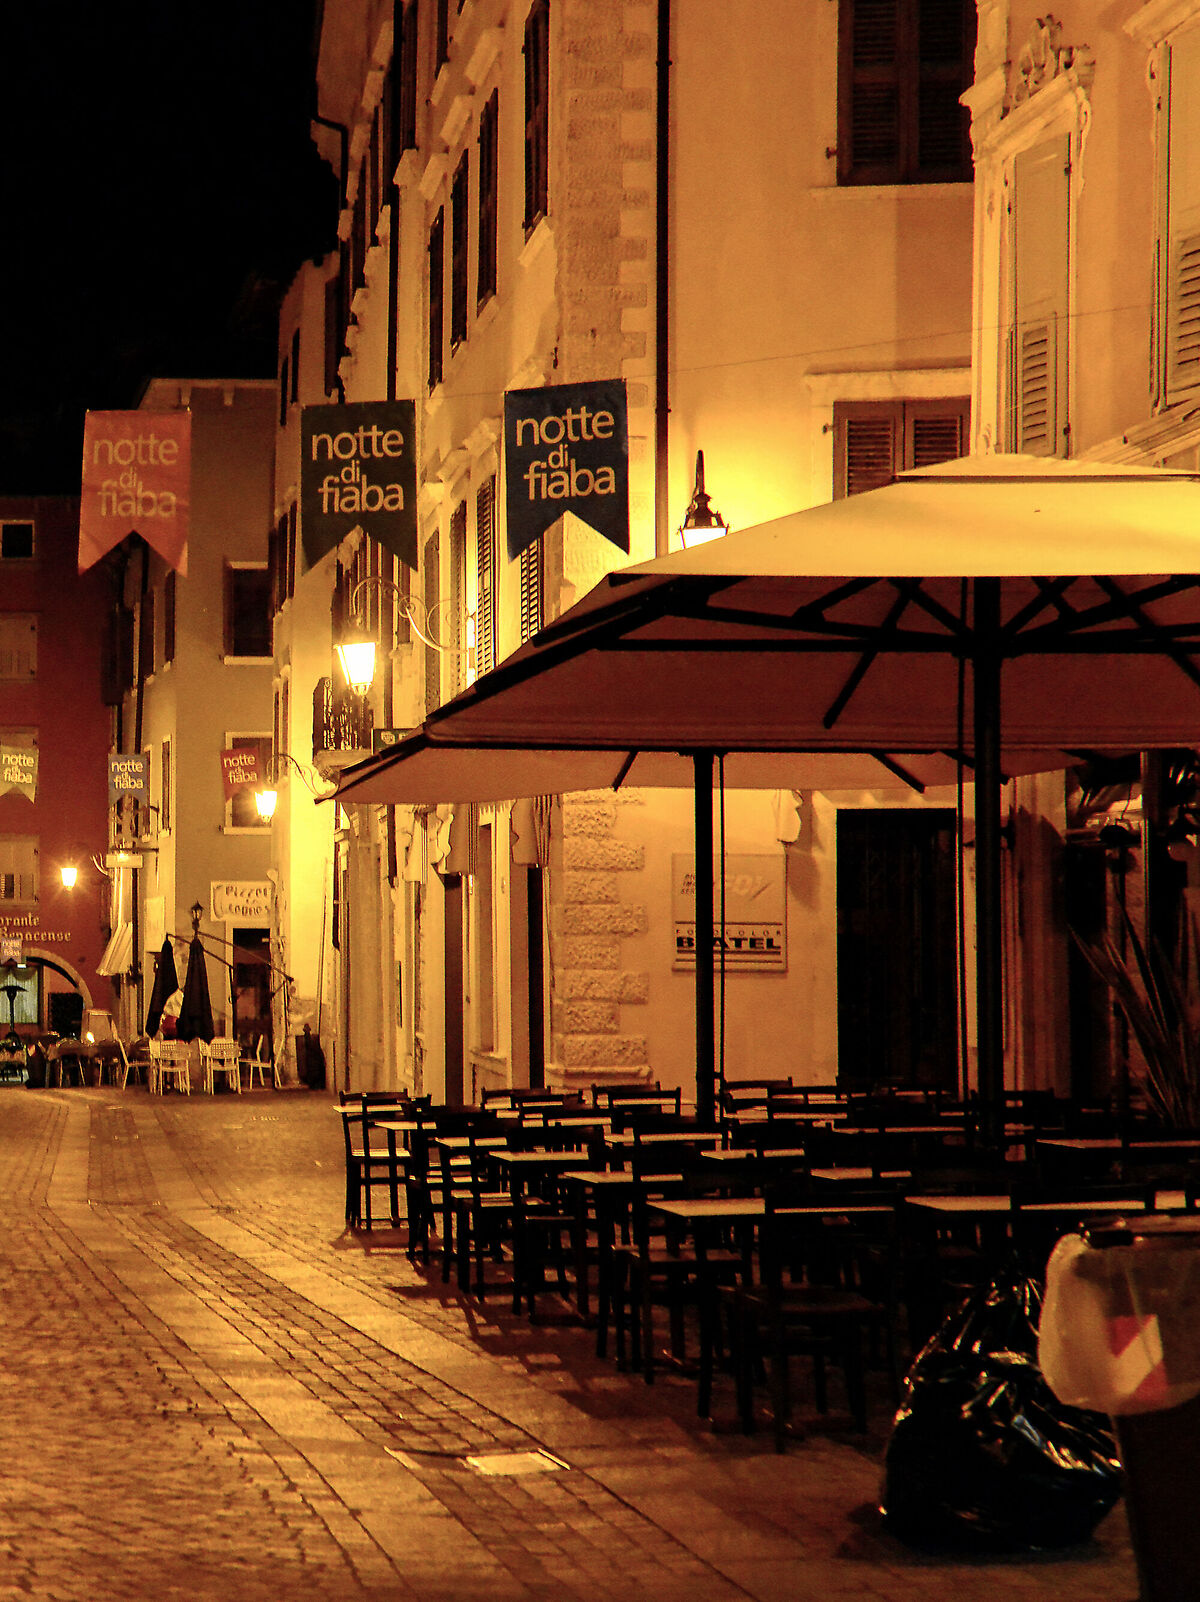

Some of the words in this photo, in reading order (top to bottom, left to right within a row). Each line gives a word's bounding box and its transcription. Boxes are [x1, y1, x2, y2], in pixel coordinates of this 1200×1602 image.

[516, 406, 615, 446] notte
[92, 433, 179, 465] notte
[311, 425, 404, 461] notte
[548, 444, 568, 469] di
[119, 467, 137, 489] di
[341, 460, 360, 483] di
[524, 459, 615, 501] fiaba
[98, 480, 177, 518] fiaba
[317, 475, 404, 513] fiaba
[2, 753, 34, 767] notte
[111, 760, 143, 773] notte
[224, 753, 255, 767] notte
[3, 767, 33, 783] fiaba
[114, 775, 143, 789] fiaba
[228, 769, 258, 784] fiaba
